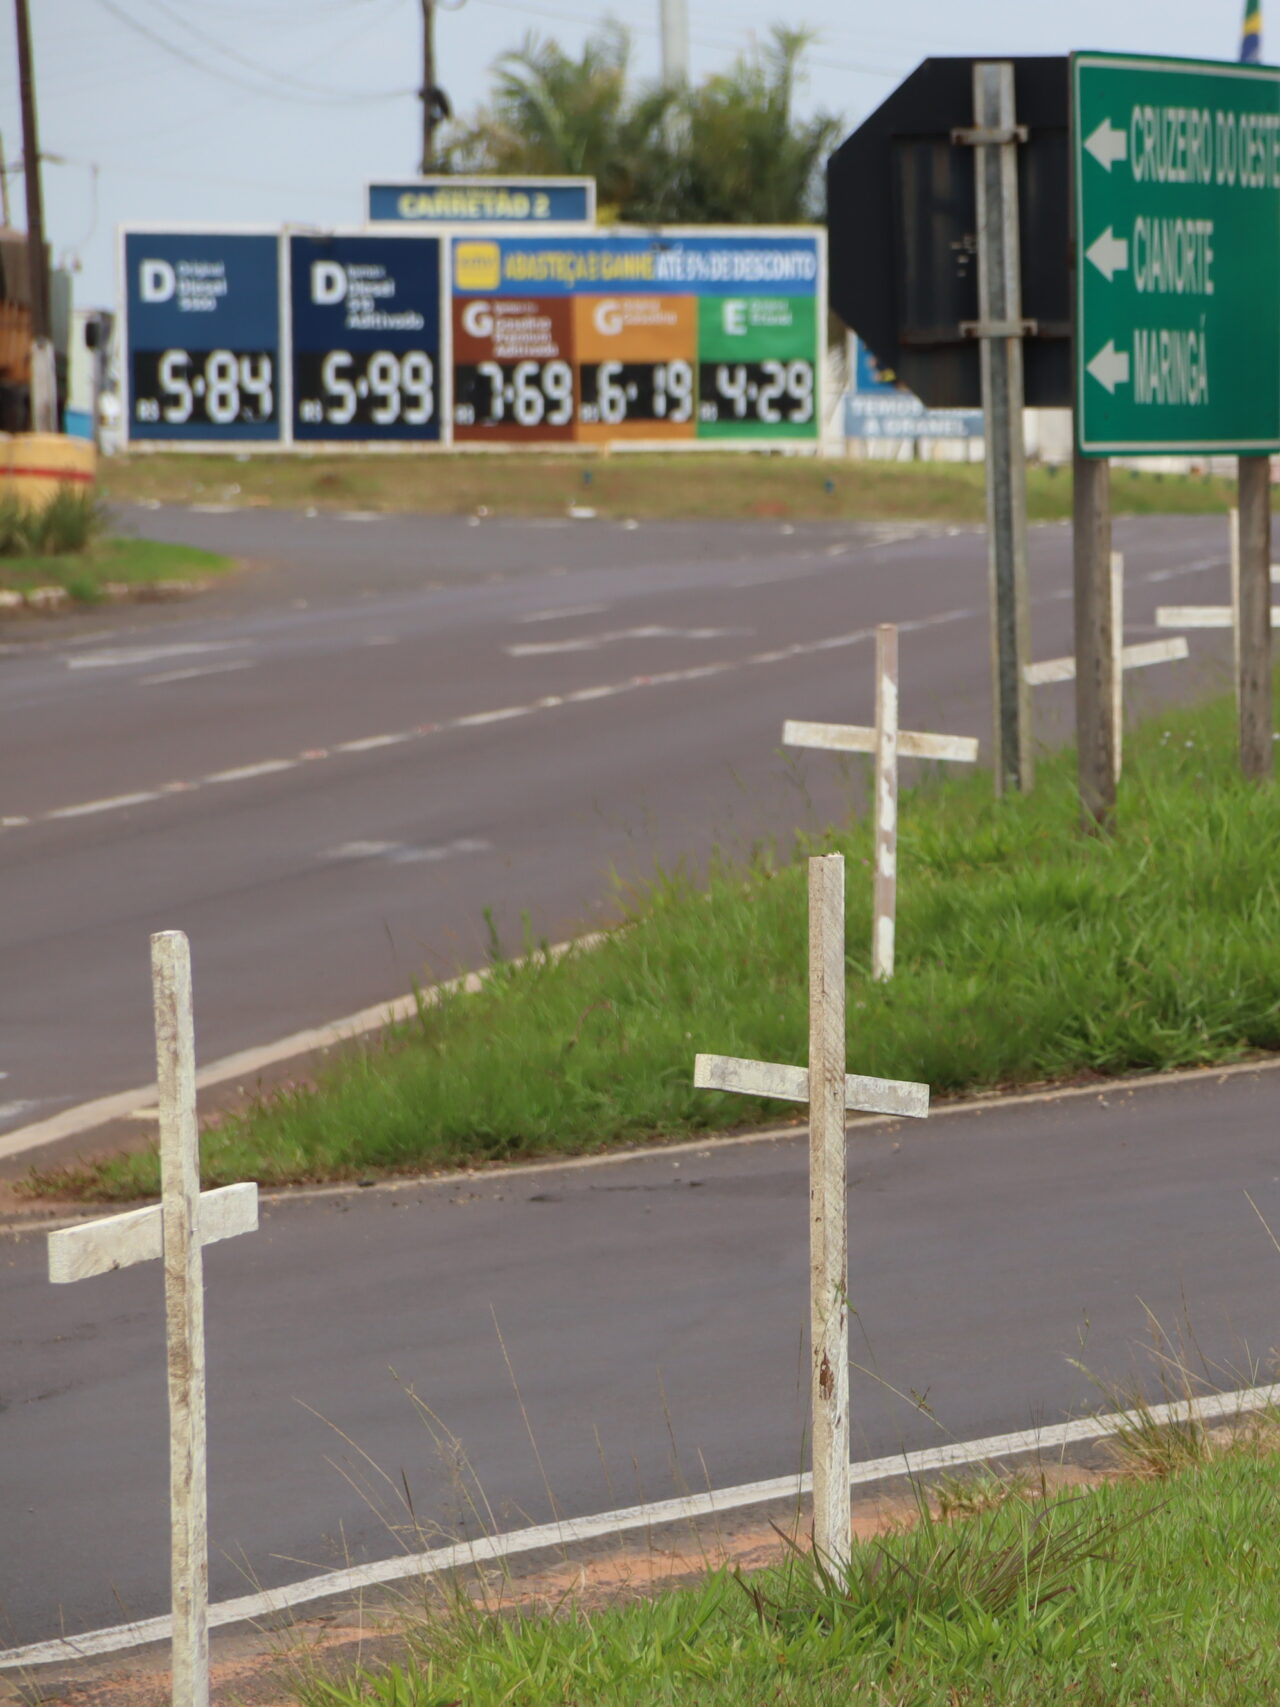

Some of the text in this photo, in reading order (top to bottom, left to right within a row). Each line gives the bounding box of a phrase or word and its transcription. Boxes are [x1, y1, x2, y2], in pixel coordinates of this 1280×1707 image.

[1131, 104, 1280, 188] CRUZEIRO DO OESTE
[531, 192, 550, 219] 2
[733, 251, 817, 281] DESCONTO
[1133, 215, 1215, 295] CIANORTE
[140, 258, 176, 303] D
[311, 260, 347, 305] D
[462, 300, 493, 338] G
[593, 299, 624, 337] G
[724, 299, 748, 336] E
[1133, 313, 1209, 406] MARINGÁ
